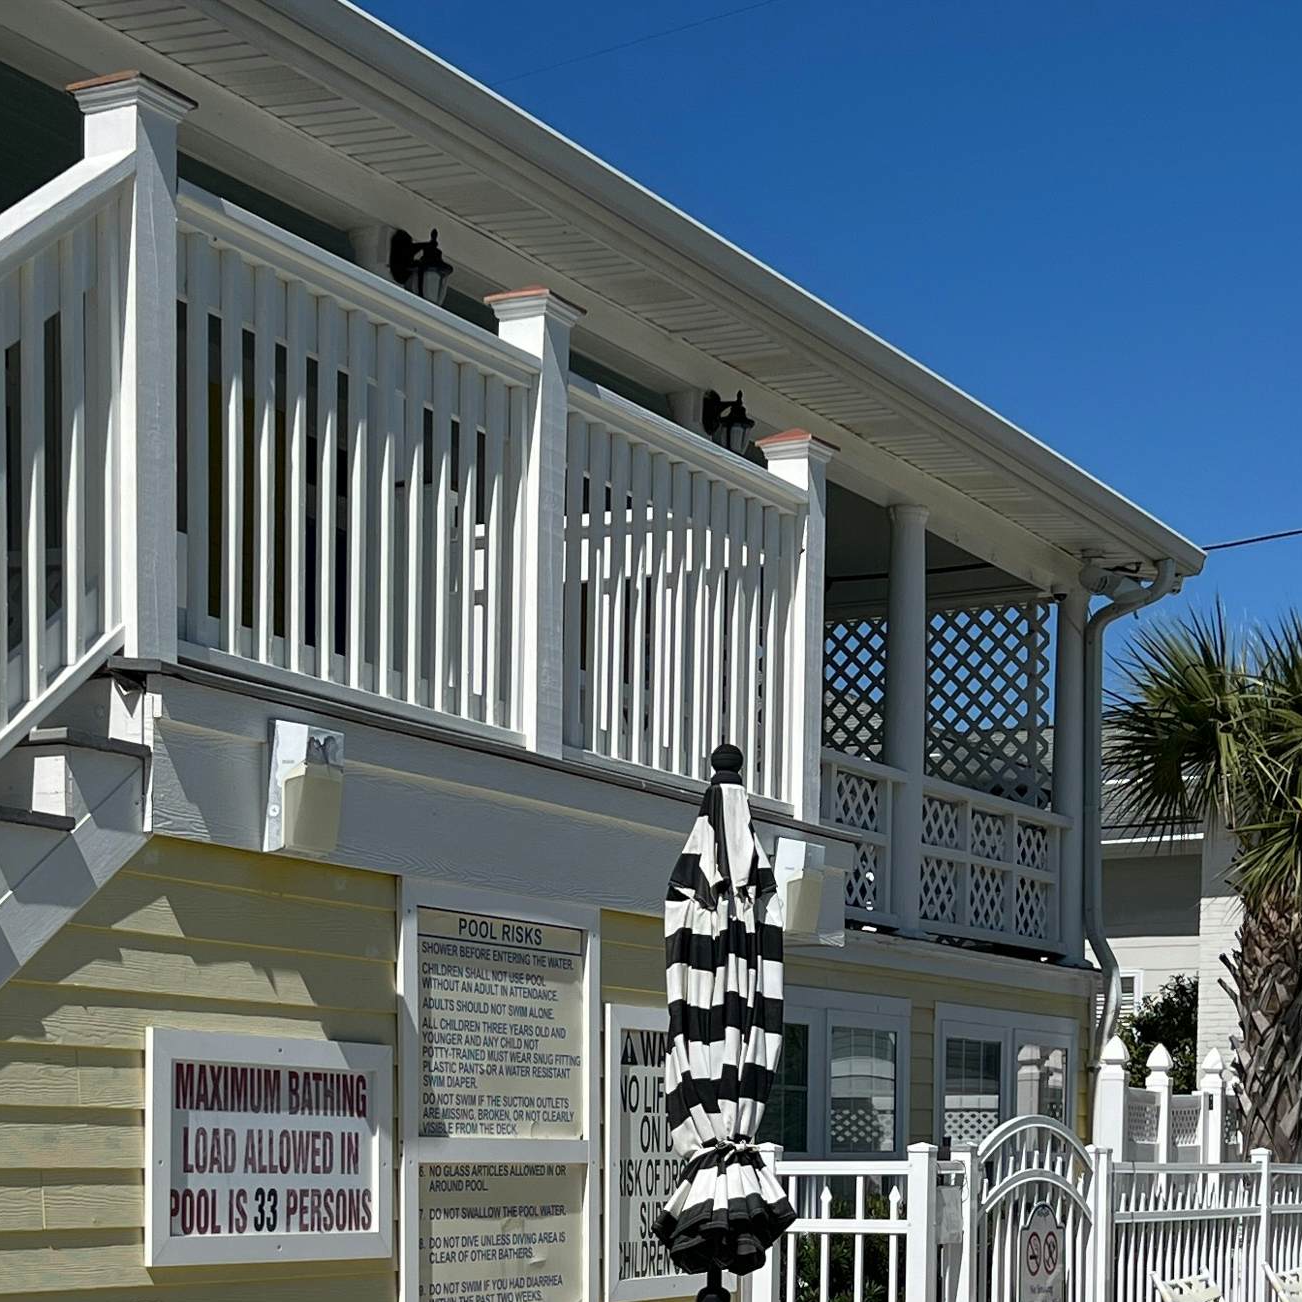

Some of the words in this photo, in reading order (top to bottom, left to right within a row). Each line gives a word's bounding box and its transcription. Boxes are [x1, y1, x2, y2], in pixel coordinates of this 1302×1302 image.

[459, 918, 497, 940] POOL
[502, 924, 542, 945] RISKS
[422, 941, 458, 956] SHOWER
[460, 946, 490, 960] BEFORE
[493, 949, 530, 965] ENTERING
[533, 955, 546, 967] THE
[422, 963, 463, 977] CHILDREN
[466, 967, 490, 980] SHALL
[492, 971, 507, 982] NOT
[510, 973, 523, 983] USE
[526, 975, 546, 986] POOL
[422, 977, 458, 991] WITHOUT
[462, 982, 472, 992] AN
[474, 982, 499, 995] ADULT
[501, 986, 508, 996] IN
[423, 998, 454, 1011] ADULTS
[457, 1001, 488, 1014] SHOULD
[491, 1005, 506, 1015] NOT
[508, 1007, 527, 1017] SWIM
[422, 1018, 437, 1030] ALL
[440, 1019, 480, 1033] CHILDREN
[482, 1022, 507, 1034] THREE
[510, 1024, 533, 1036] YEARS
[535, 1027, 549, 1037] OLD
[551, 1028, 566, 1039] AND
[422, 1032, 462, 1045] YOUNGER
[464, 1036, 481, 1046] AND
[483, 1037, 498, 1047] ANY
[501, 1037, 522, 1049] CHILD
[524, 1039, 539, 1050] NOT
[488, 1051, 508, 1062] MUST
[510, 1052, 531, 1063] WEAR
[533, 1053, 553, 1065] SNUG
[555, 1055, 580, 1067] FITTING
[423, 1061, 456, 1073] PLASTIC
[486, 1065, 497, 1075] OR
[499, 1066, 505, 1075] A
[506, 1066, 531, 1077] WATER
[533, 1067, 570, 1079] RESISTANT
[175, 1063, 281, 1114] MAXIMUM
[288, 1071, 367, 1118] BATHING
[423, 1075, 445, 1087] SWIM
[423, 1093, 435, 1105] DO
[437, 1093, 453, 1105] NOT
[456, 1094, 476, 1105] SWIM
[478, 1095, 485, 1105] IF
[487, 1096, 500, 1106] THE
[503, 1096, 536, 1108] SUCTION
[537, 1097, 569, 1109] OUTLETS
[620, 1075, 639, 1112] NO
[423, 1108, 440, 1119] ARE
[513, 1111, 523, 1121] OR
[526, 1111, 540, 1121] NOT
[543, 1111, 574, 1122] CLEARLY
[456, 1123, 478, 1134] FROM
[480, 1123, 494, 1134] THE
[640, 1115, 660, 1152] ON
[183, 1126, 237, 1174] LOAD
[244, 1129, 333, 1174] ALLOWED
[341, 1132, 359, 1174] IN
[429, 1166, 441, 1177] NO
[443, 1166, 470, 1177] GLASS
[471, 1166, 508, 1177] ARTICLES
[510, 1165, 545, 1177] ALLOWED
[548, 1165, 554, 1176] IN
[556, 1165, 566, 1175] OR
[646, 1159, 660, 1196] OF
[429, 1180, 463, 1192] AROUND
[170, 1187, 221, 1233] POOL
[229, 1188, 247, 1233] IS
[254, 1187, 277, 1232] 33
[286, 1188, 372, 1233] PERSONS
[429, 1208, 442, 1220] DO
[443, 1207, 460, 1220] NOT
[462, 1206, 501, 1219] SWALLOW
[503, 1206, 517, 1217] THE
[519, 1206, 538, 1217] POOL
[429, 1237, 441, 1249] DO
[443, 1236, 459, 1249] NOT
[462, 1235, 479, 1248] DIVE
[481, 1234, 510, 1246] UNLESS
[512, 1232, 536, 1245] DIVING
[538, 1232, 557, 1243] AREA
[559, 1232, 565, 1242] IS
[429, 1251, 456, 1264] CLEAR
[458, 1251, 469, 1262] OF
[471, 1249, 496, 1262] OTHER
[429, 1283, 441, 1296] DO
[443, 1283, 459, 1295] NOT
[461, 1281, 482, 1293] SWIM
[484, 1280, 490, 1292] IF
[492, 1279, 508, 1291] YOU
[510, 1278, 525, 1289] HAD
[527, 1275, 563, 1288] DIARRHEA
